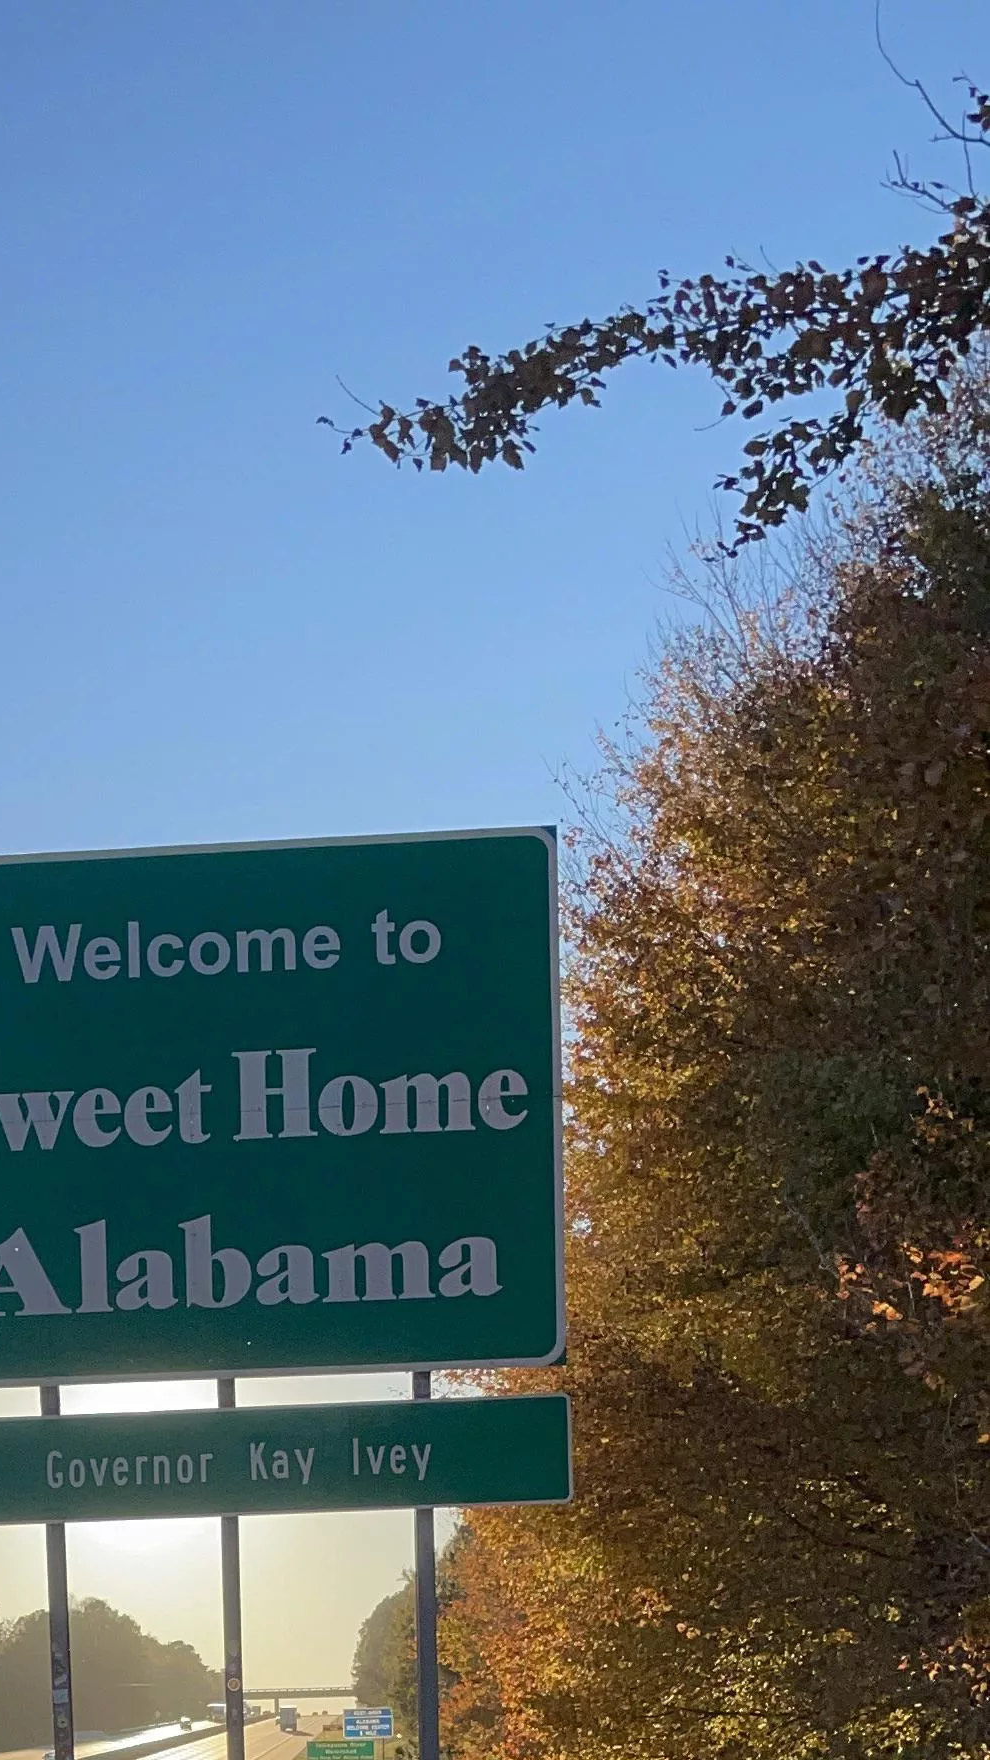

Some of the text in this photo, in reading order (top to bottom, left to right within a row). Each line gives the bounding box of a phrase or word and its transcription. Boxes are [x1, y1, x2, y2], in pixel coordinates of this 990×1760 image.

[11, 909, 441, 983] Welcome to
[231, 1047, 528, 1142] Home
[46, 1437, 432, 1490] Governor Kay Ivey
